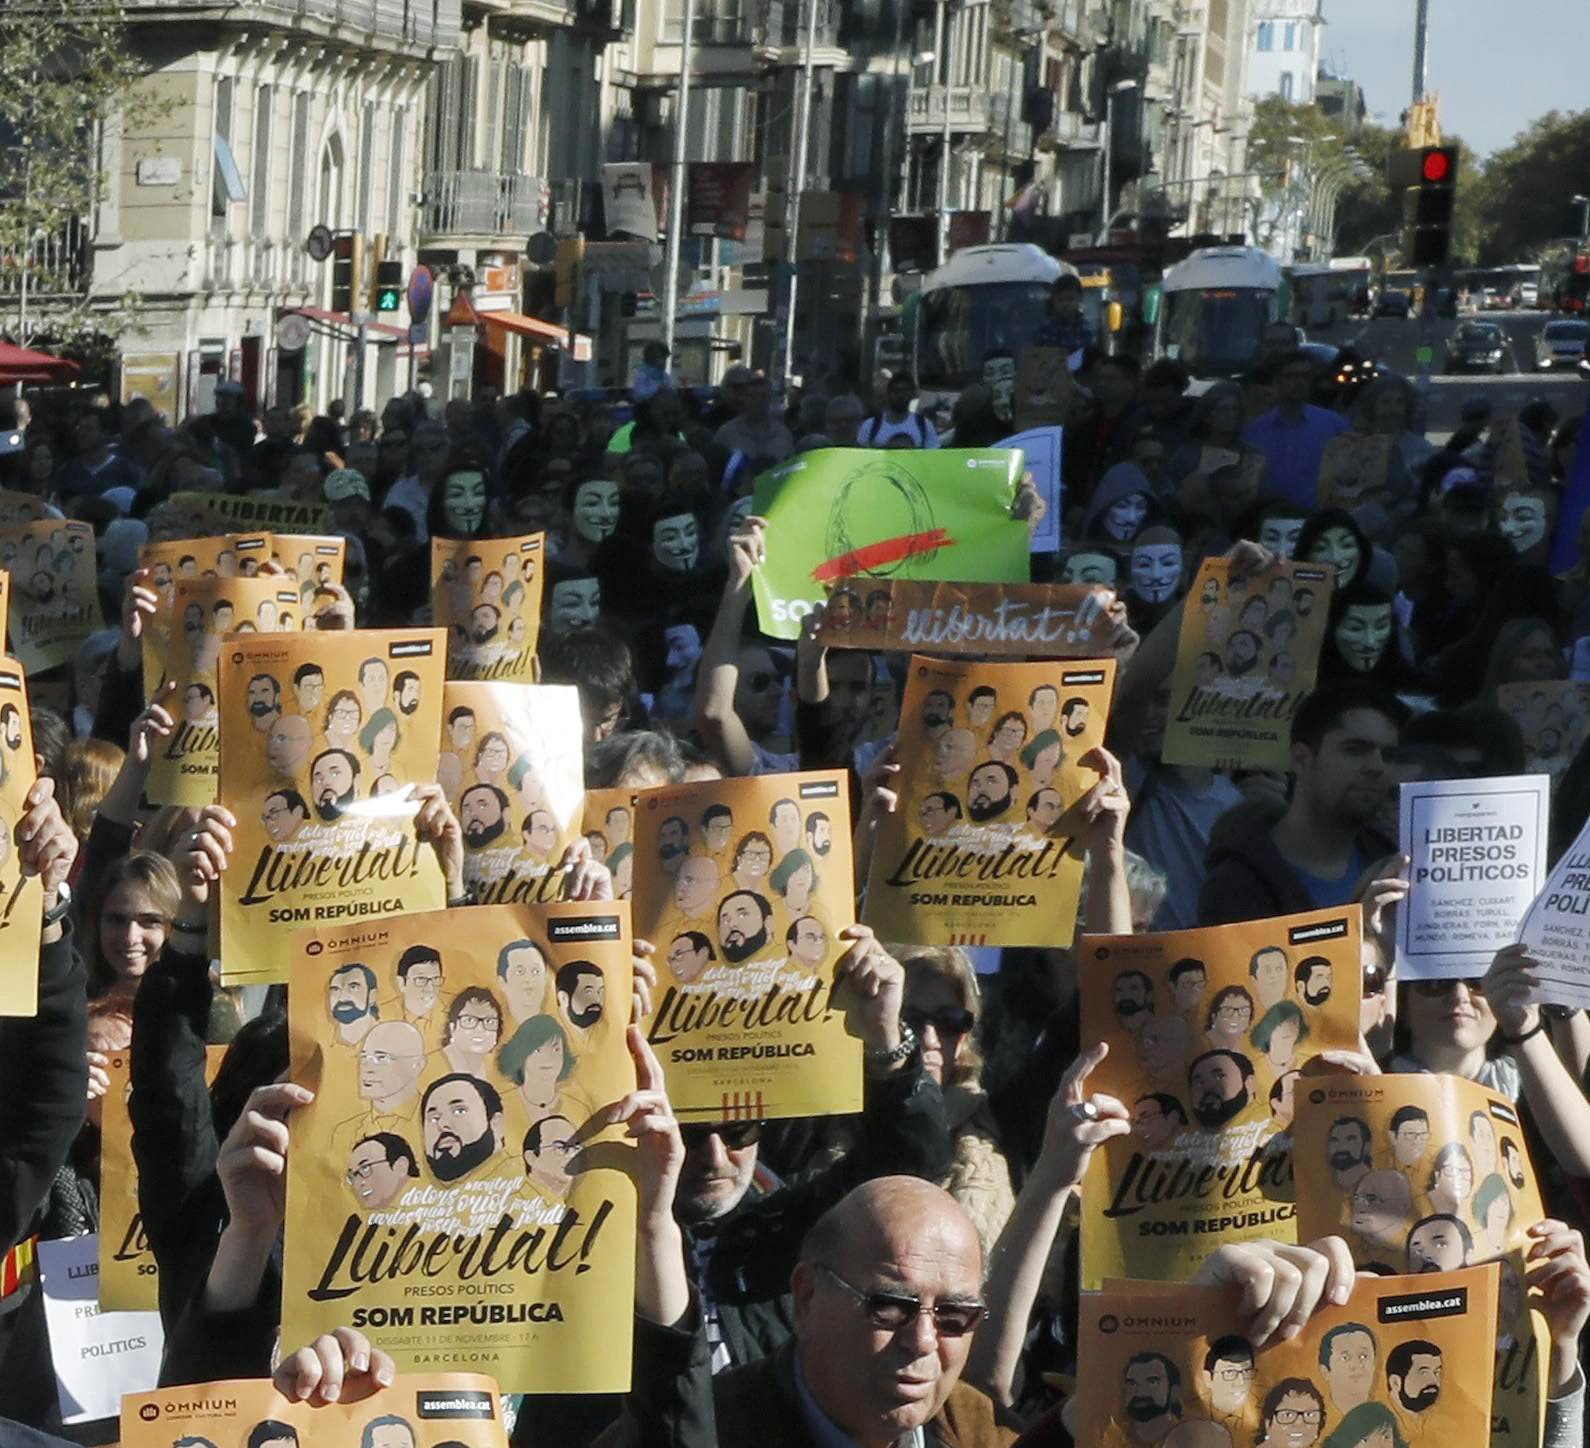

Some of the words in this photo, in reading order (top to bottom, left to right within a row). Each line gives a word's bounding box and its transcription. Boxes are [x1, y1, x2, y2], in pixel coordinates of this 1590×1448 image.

[1425, 825, 1523, 844] LIBERTAD
[887, 836, 1070, 887] Llibertat!
[1432, 845, 1516, 863] PRESOS
[240, 845, 421, 904] Llibertat!
[1417, 864, 1529, 883] POLÍTICOS
[307, 1201, 613, 1301] Llibertat!
[81, 1336, 146, 1359] POLITICS
